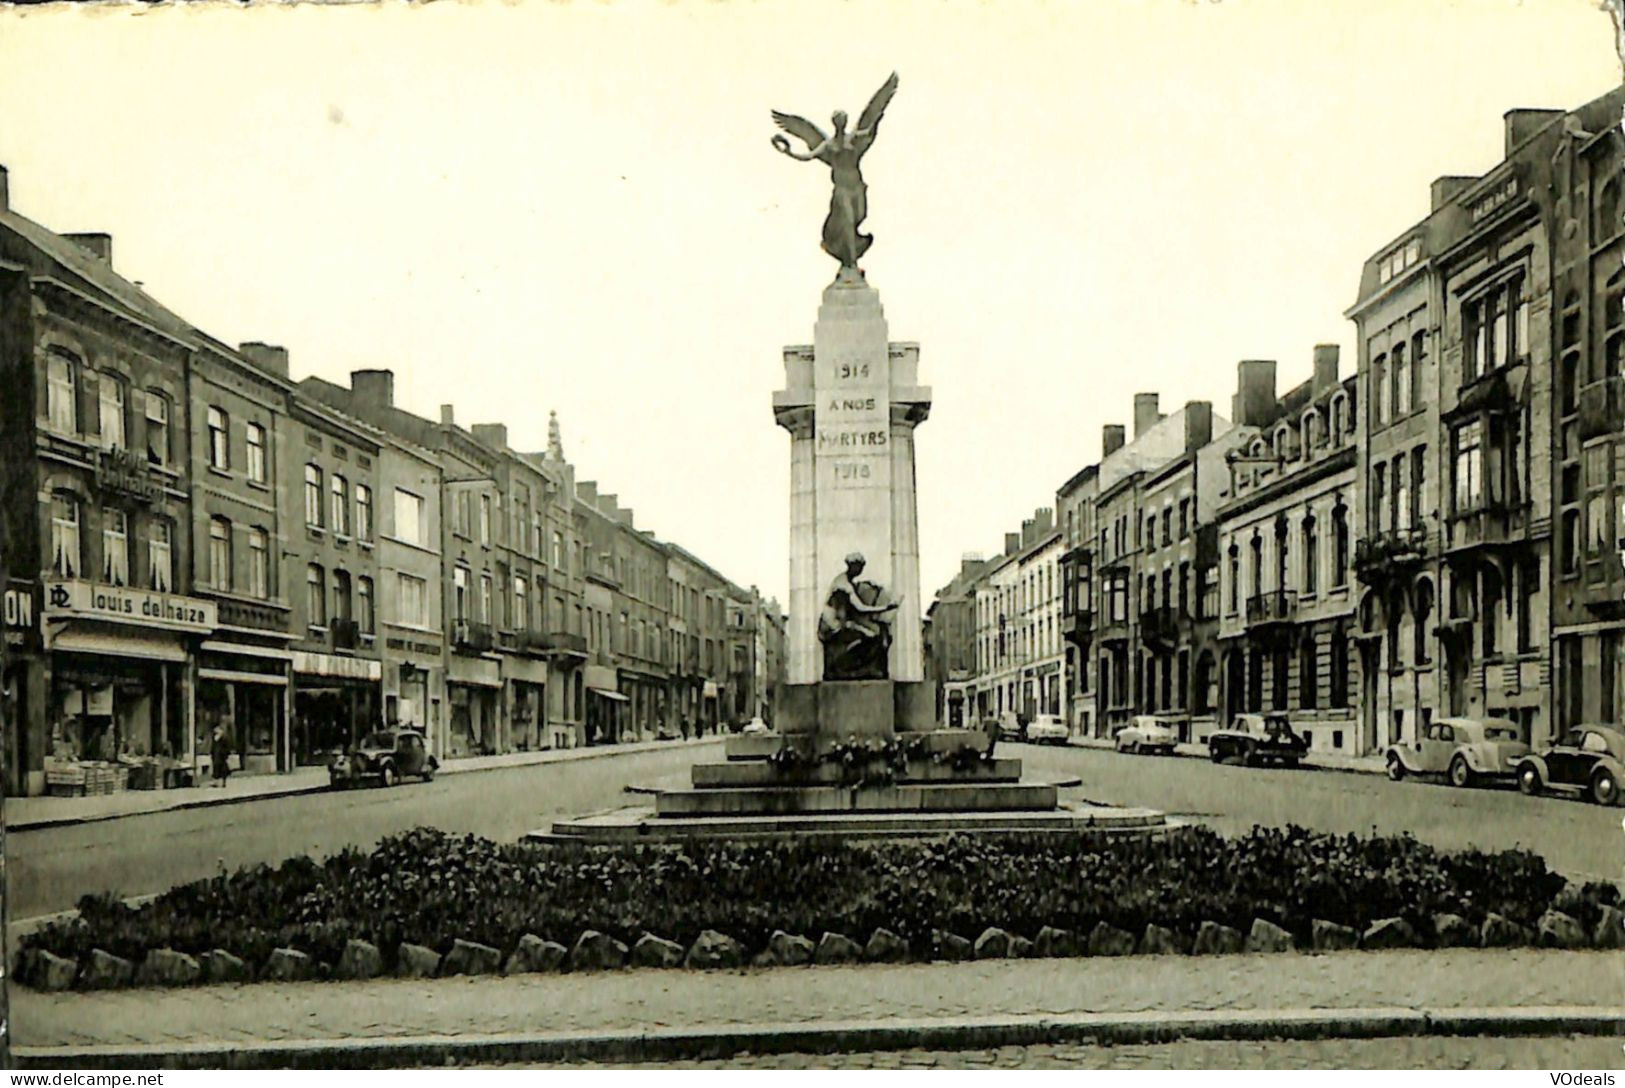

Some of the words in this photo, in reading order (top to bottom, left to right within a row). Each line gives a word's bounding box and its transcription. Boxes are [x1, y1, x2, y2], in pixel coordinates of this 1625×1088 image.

[834, 362, 871, 379] 1914
[828, 400, 839, 412] A
[842, 398, 876, 412] NOS
[818, 430, 887, 449] MARTYRS
[4, 590, 32, 627] ON
[91, 593, 132, 613] louis
[142, 597, 205, 623] delhaize
